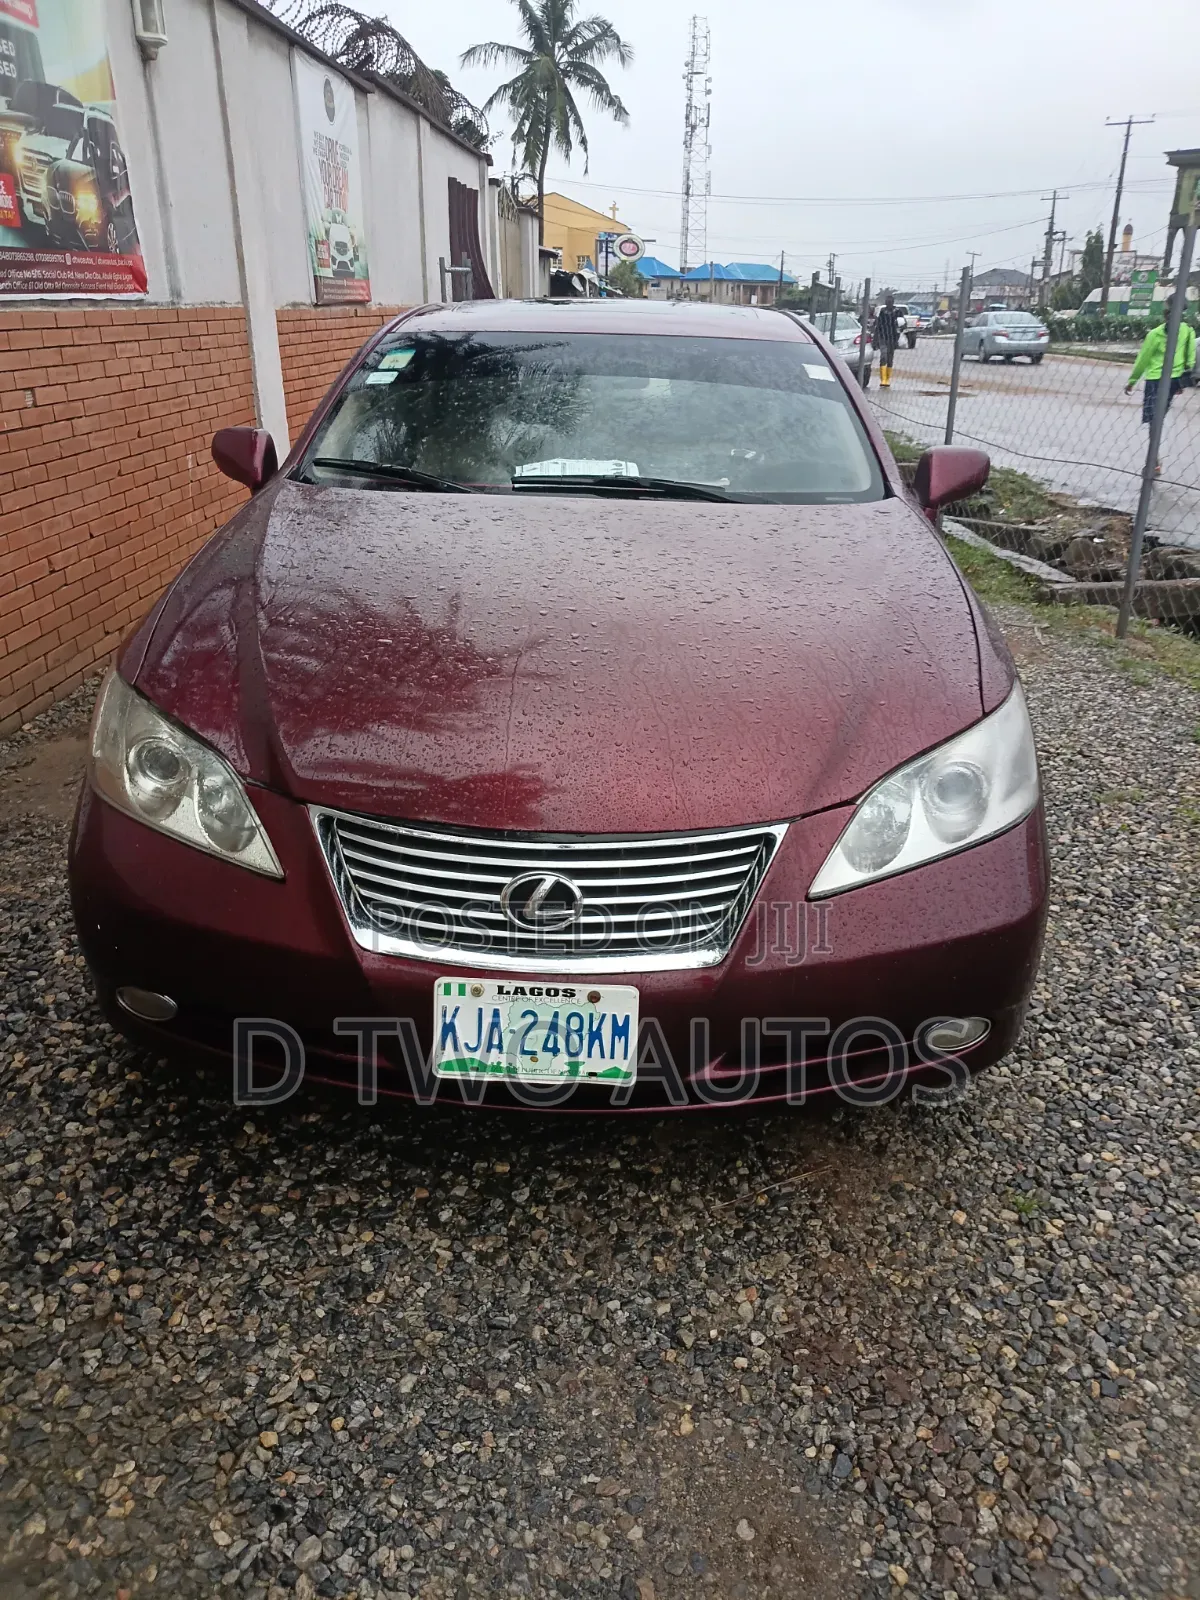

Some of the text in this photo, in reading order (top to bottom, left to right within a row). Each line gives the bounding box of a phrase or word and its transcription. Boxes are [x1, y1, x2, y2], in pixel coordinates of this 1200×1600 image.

[496, 984, 576, 998] LAGOS
[491, 995, 520, 1003] CENTRE
[534, 996, 583, 1004] EXCELLENCE
